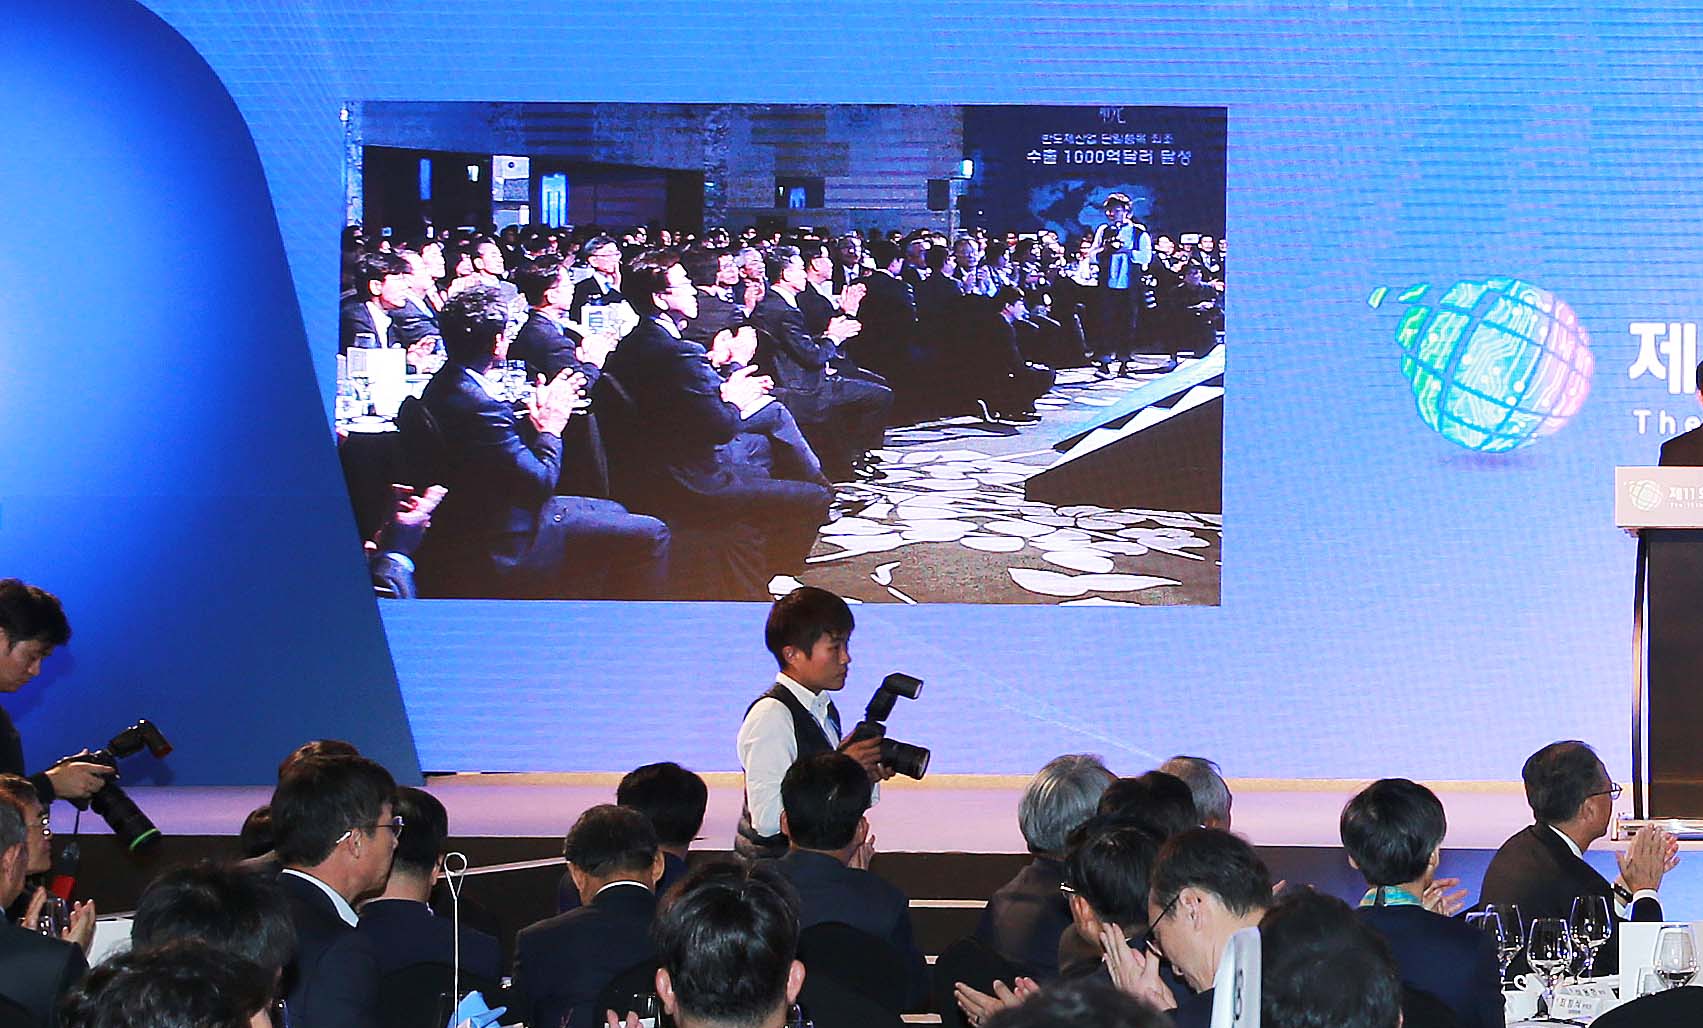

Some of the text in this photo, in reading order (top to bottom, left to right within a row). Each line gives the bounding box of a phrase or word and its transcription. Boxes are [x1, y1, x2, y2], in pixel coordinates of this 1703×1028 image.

[1026, 149, 1192, 166] 수출 1000억달러 달성
[1633, 409, 1701, 435] The
